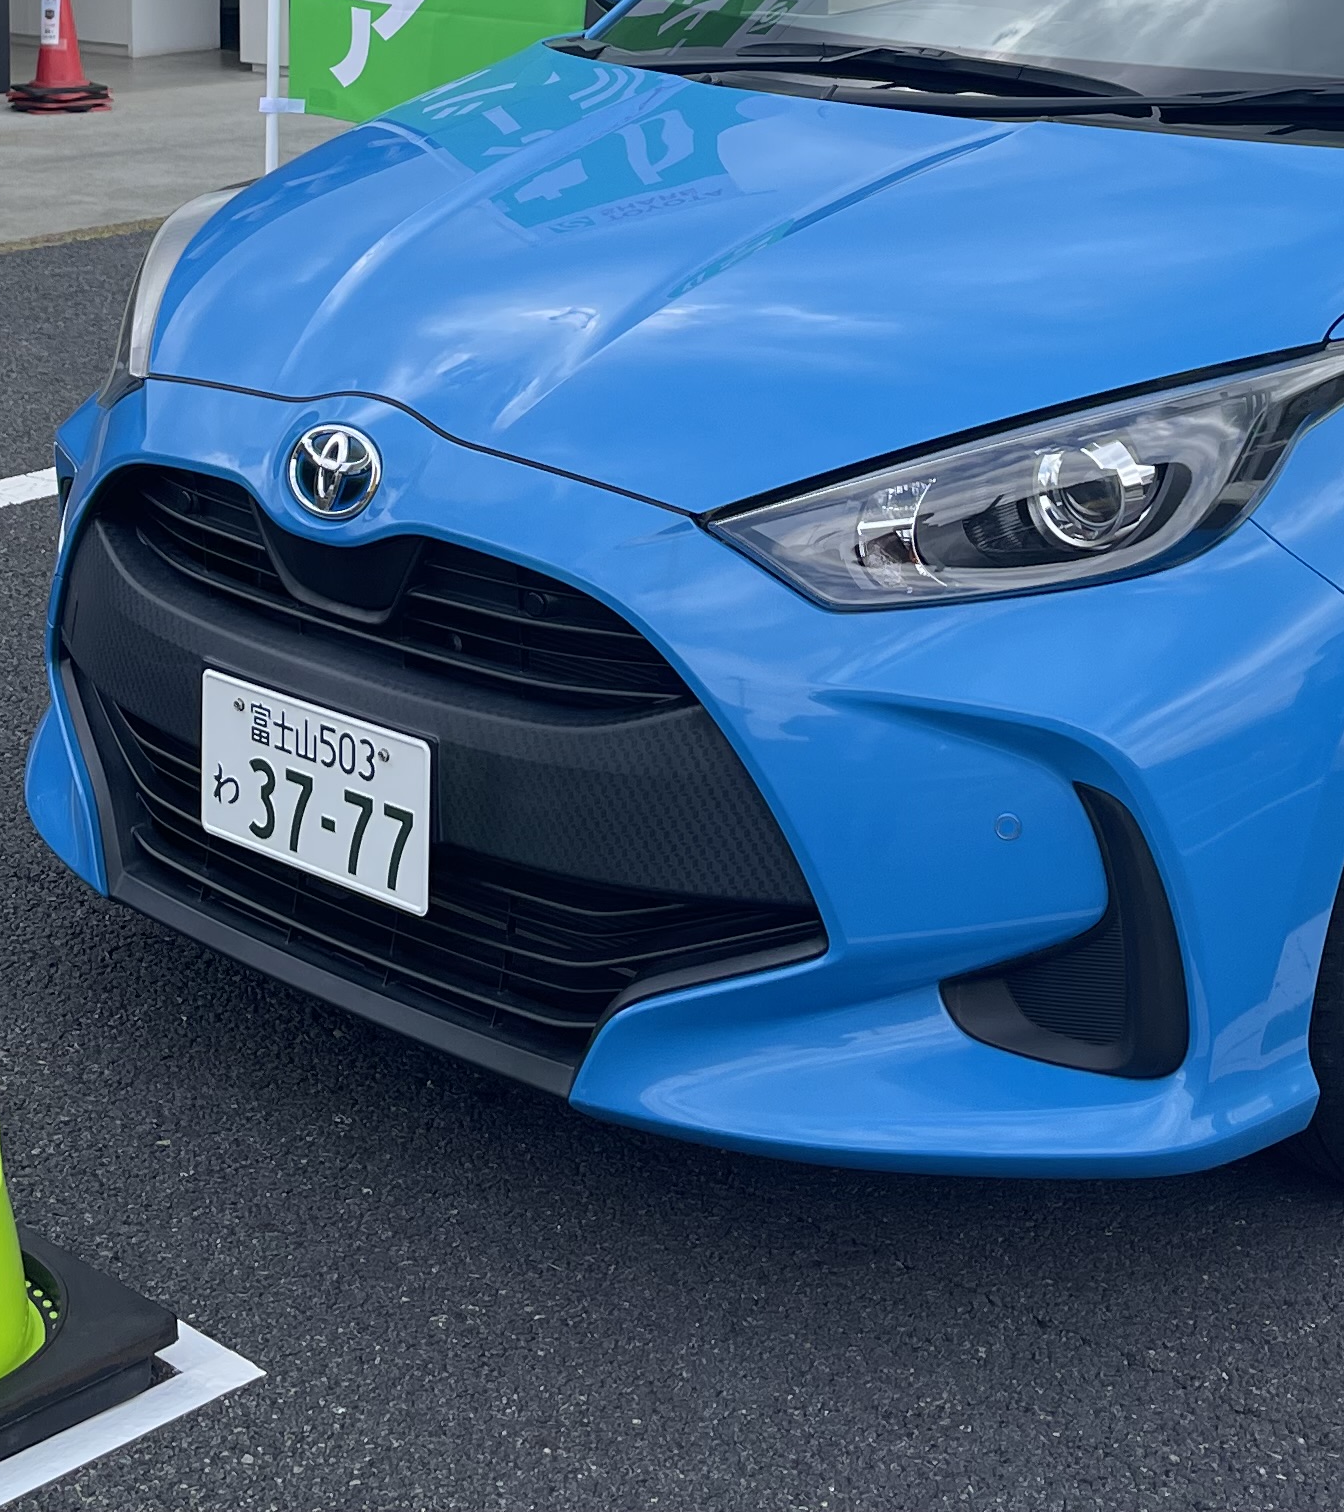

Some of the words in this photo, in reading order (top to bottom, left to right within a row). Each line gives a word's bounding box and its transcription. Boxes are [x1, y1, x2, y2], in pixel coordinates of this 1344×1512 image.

[250, 702, 376, 782] 富士山503
[212, 761, 240, 805] わ
[248, 757, 414, 891] 37-77
